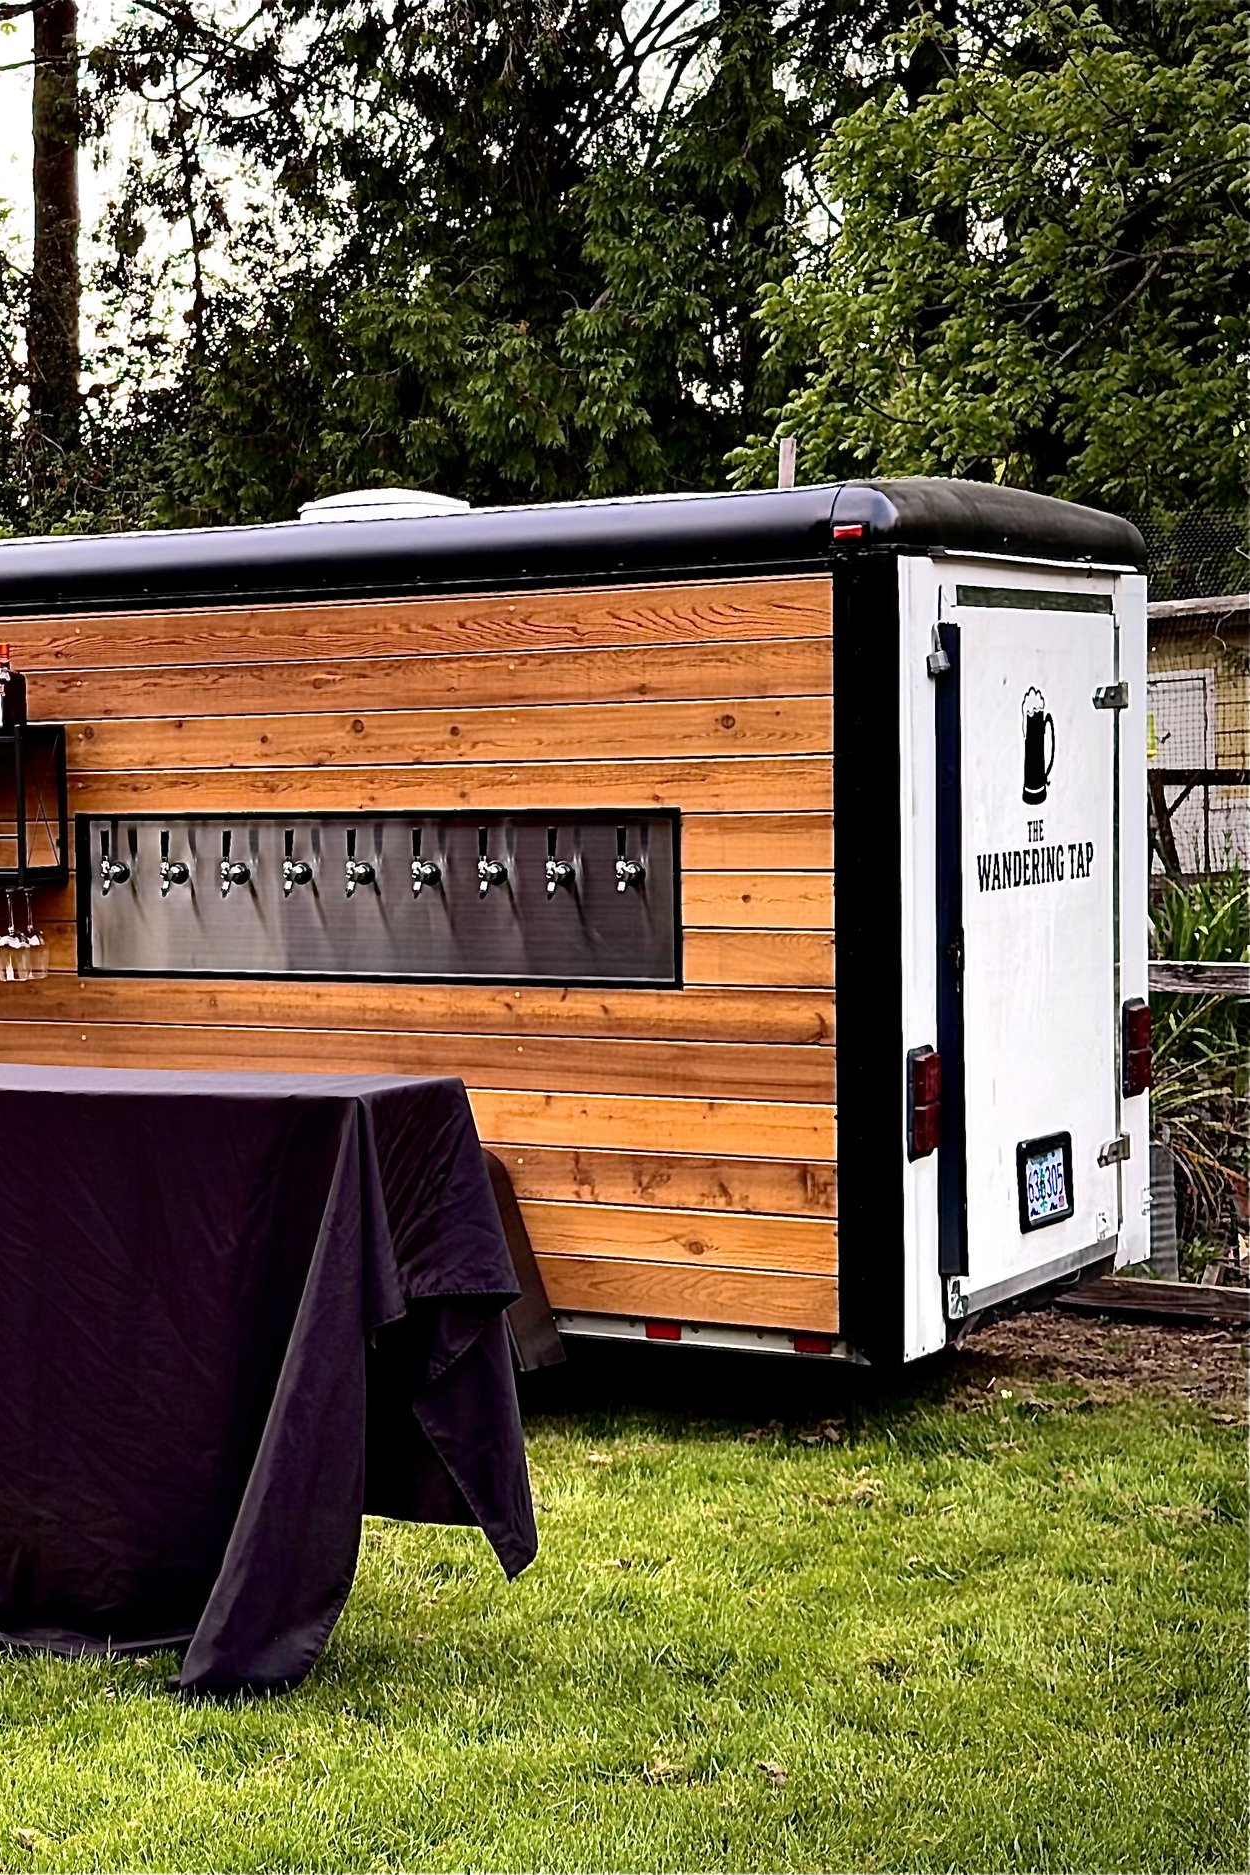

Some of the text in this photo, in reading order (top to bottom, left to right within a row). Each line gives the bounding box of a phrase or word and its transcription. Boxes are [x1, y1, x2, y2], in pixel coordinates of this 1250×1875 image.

[1027, 819, 1044, 842] THE
[977, 841, 1094, 893] WANDERING TAP
